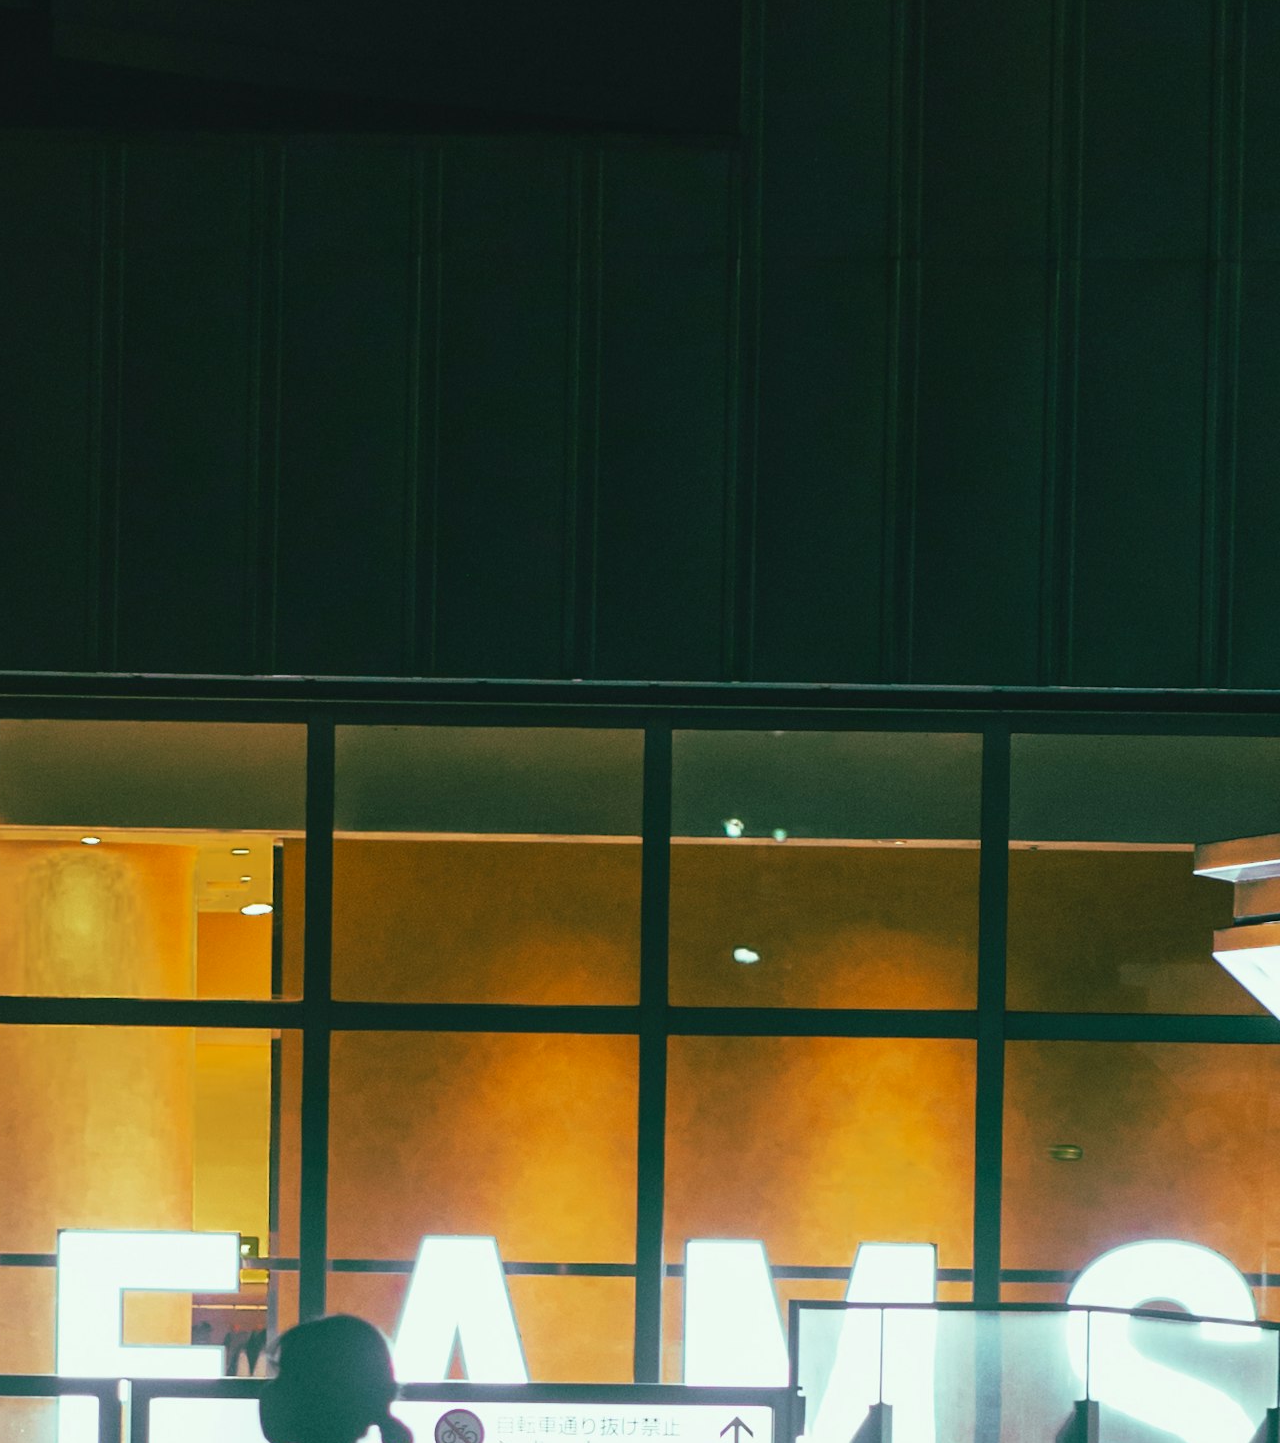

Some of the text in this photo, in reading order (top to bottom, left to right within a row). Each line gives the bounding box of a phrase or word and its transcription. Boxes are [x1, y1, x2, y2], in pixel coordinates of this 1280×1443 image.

[497, 1415, 681, 1437] 自転車通り抜け禁止
